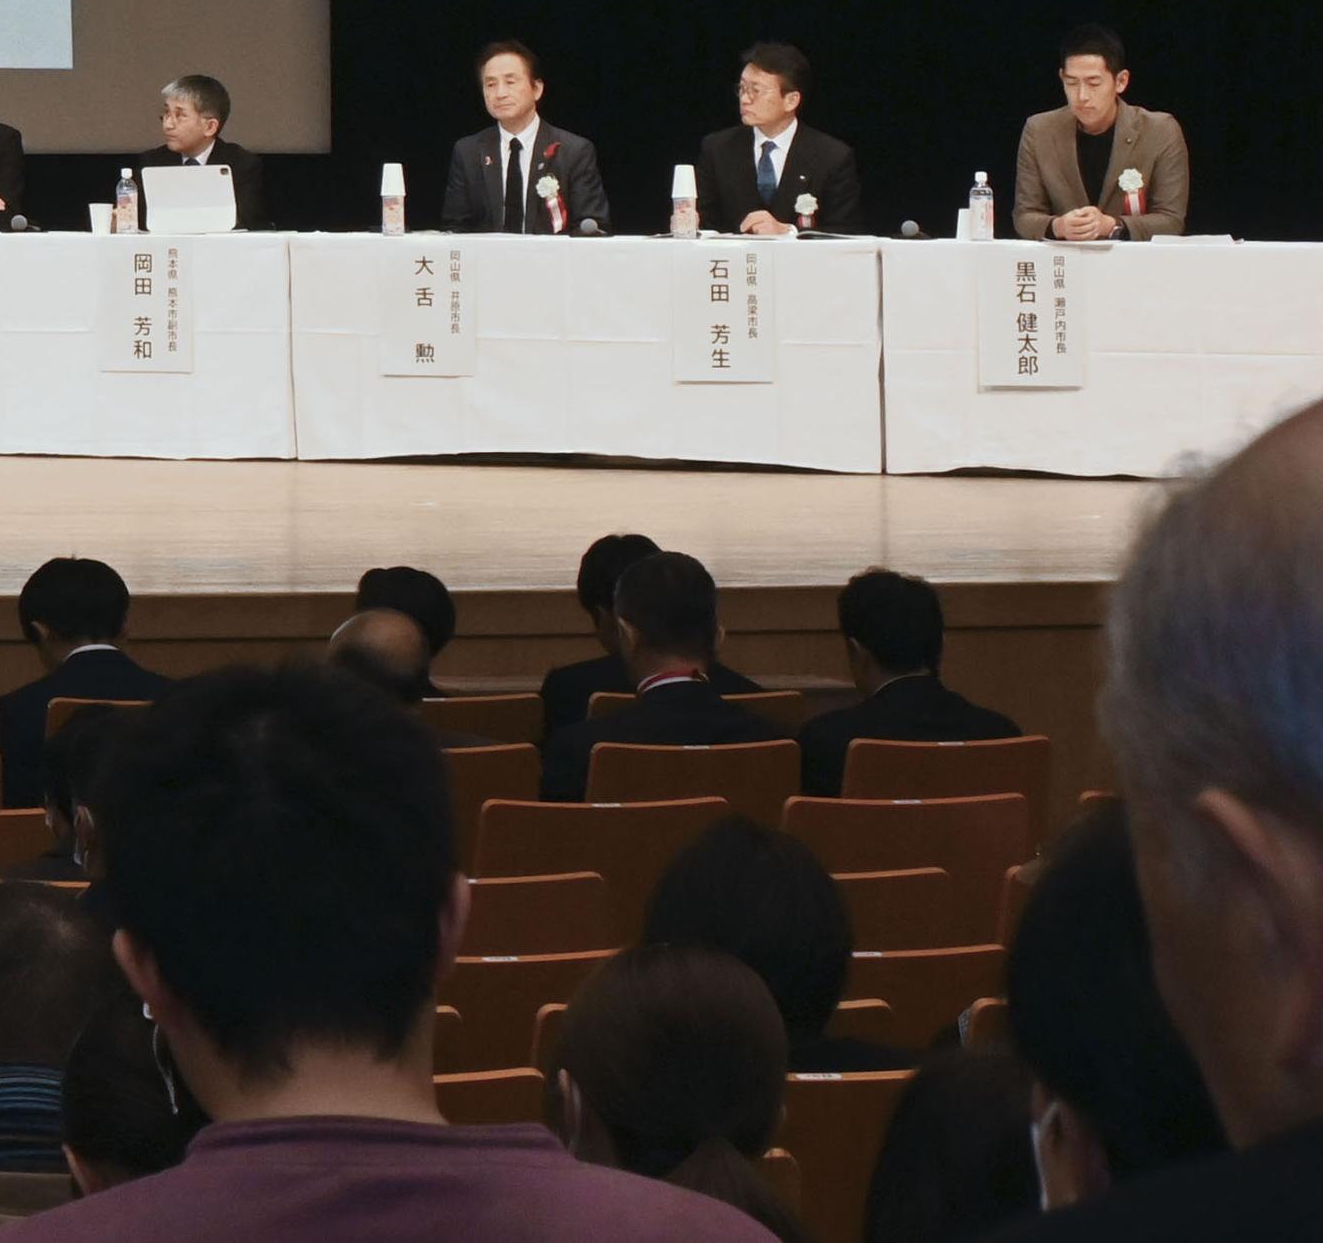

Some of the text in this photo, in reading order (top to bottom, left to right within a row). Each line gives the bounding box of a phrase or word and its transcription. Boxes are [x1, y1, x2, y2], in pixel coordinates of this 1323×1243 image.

[133, 253, 153, 360] 岡田 芳和
[414, 255, 435, 363] 大舌 勲
[449, 250, 461, 283] 岡山県
[709, 259, 732, 369] 石田 芳生
[746, 253, 758, 287] 岡山県
[1015, 261, 1039, 376] 黒石 健太郎
[1053, 255, 1066, 290] 岡山県
